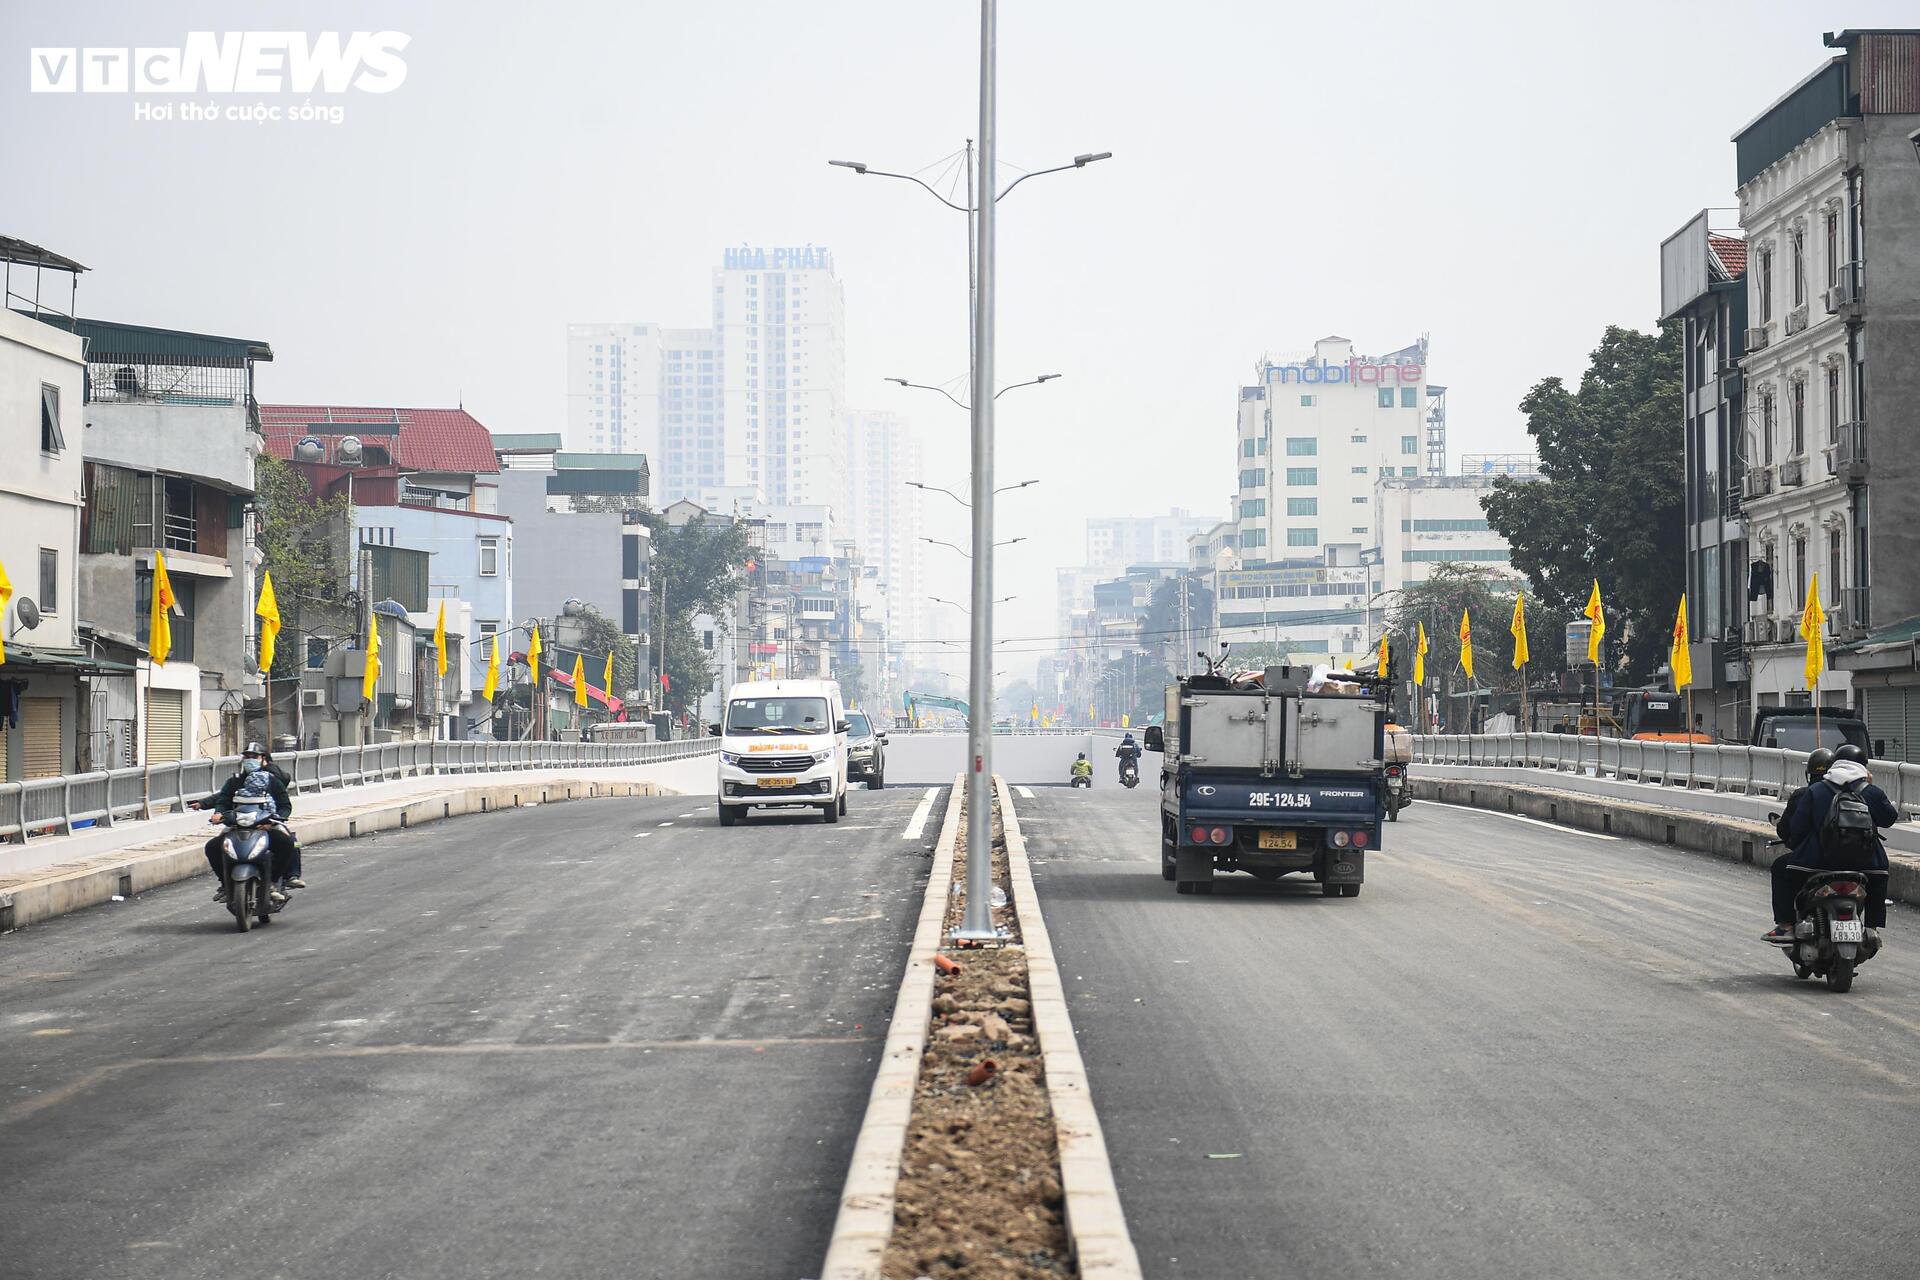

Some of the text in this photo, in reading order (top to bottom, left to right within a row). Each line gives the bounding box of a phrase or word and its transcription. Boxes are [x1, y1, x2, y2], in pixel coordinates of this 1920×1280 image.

[724, 242, 827, 270] HÒA PHÁT
[1266, 357, 1422, 384] mobifone
[1249, 792, 1312, 808] 29E-124.54
[1319, 790, 1364, 798] FRONTIER
[1269, 830, 1286, 839] 29E
[1263, 839, 1294, 849] 124.54
